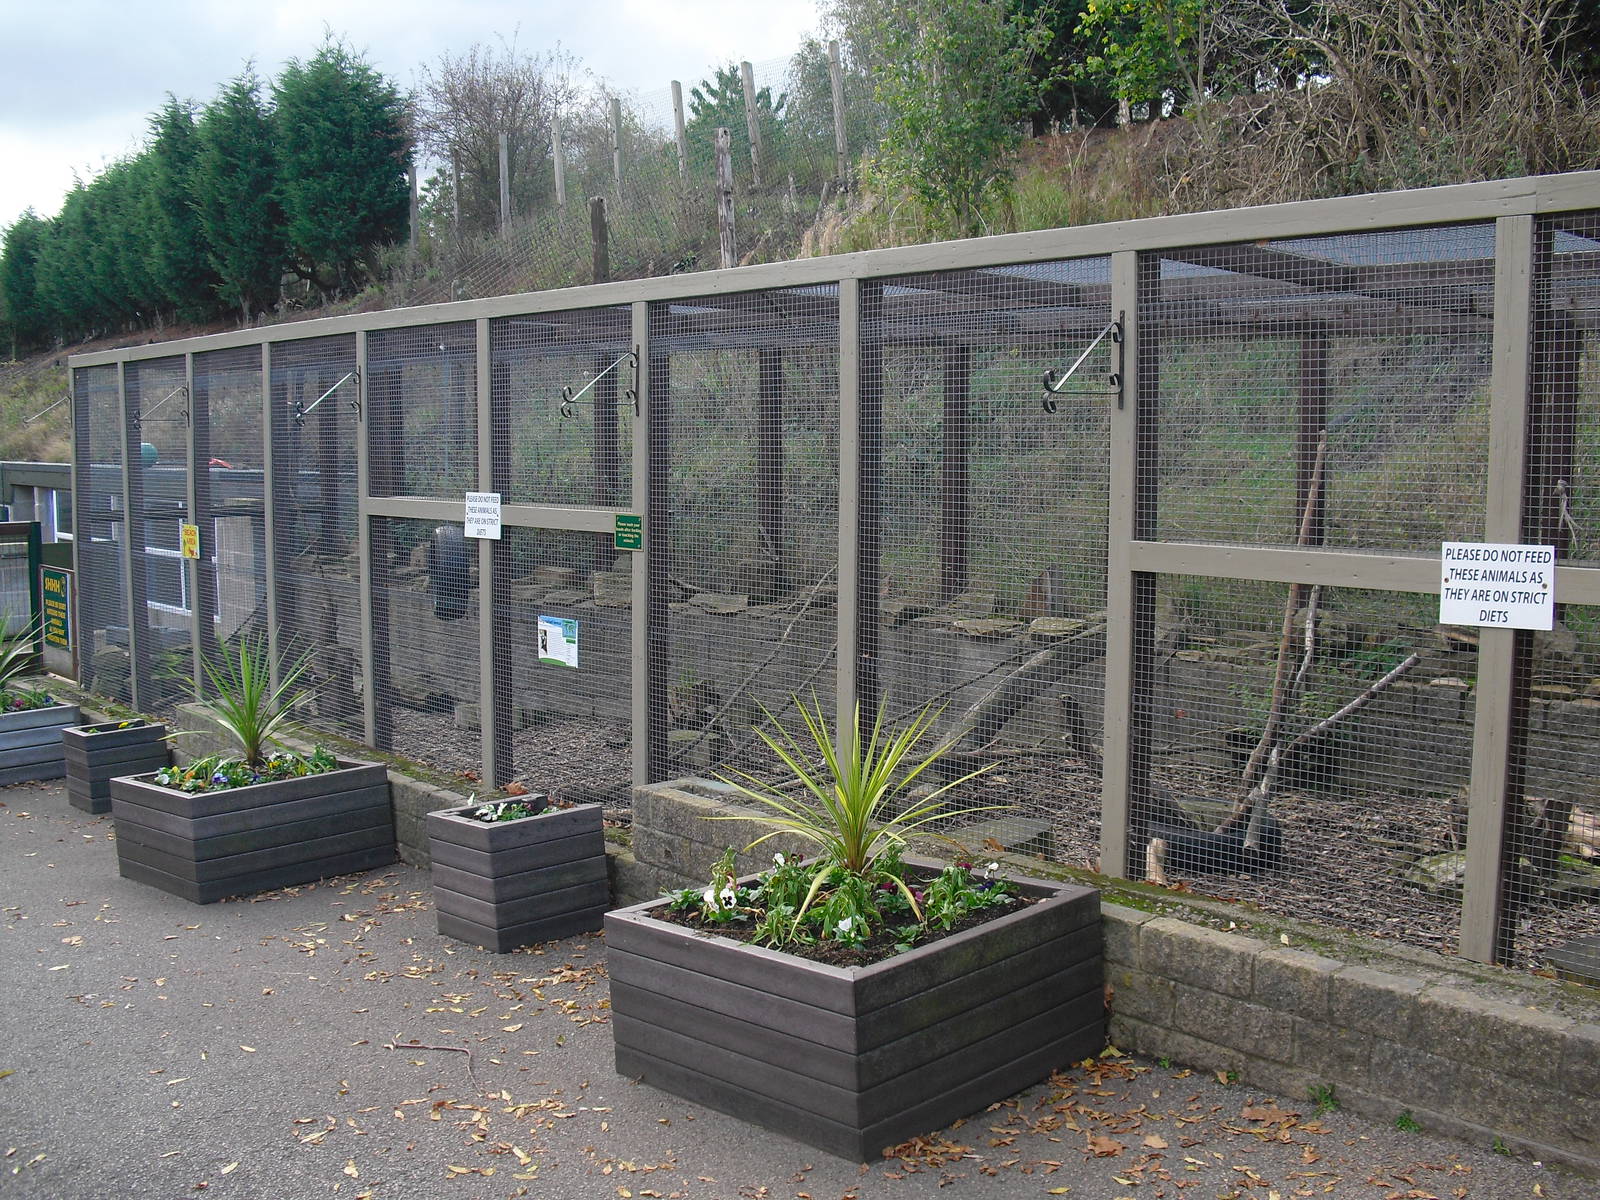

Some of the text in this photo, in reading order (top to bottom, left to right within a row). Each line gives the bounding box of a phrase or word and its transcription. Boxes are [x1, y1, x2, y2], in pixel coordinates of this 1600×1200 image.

[1446, 548, 1551, 564] PLEASE DO NOT FEED
[1450, 568, 1543, 584] THESE ANIMALS AS
[1445, 588, 1548, 604] THEY ARE ON STRICT
[1479, 609, 1508, 623] DIETS
